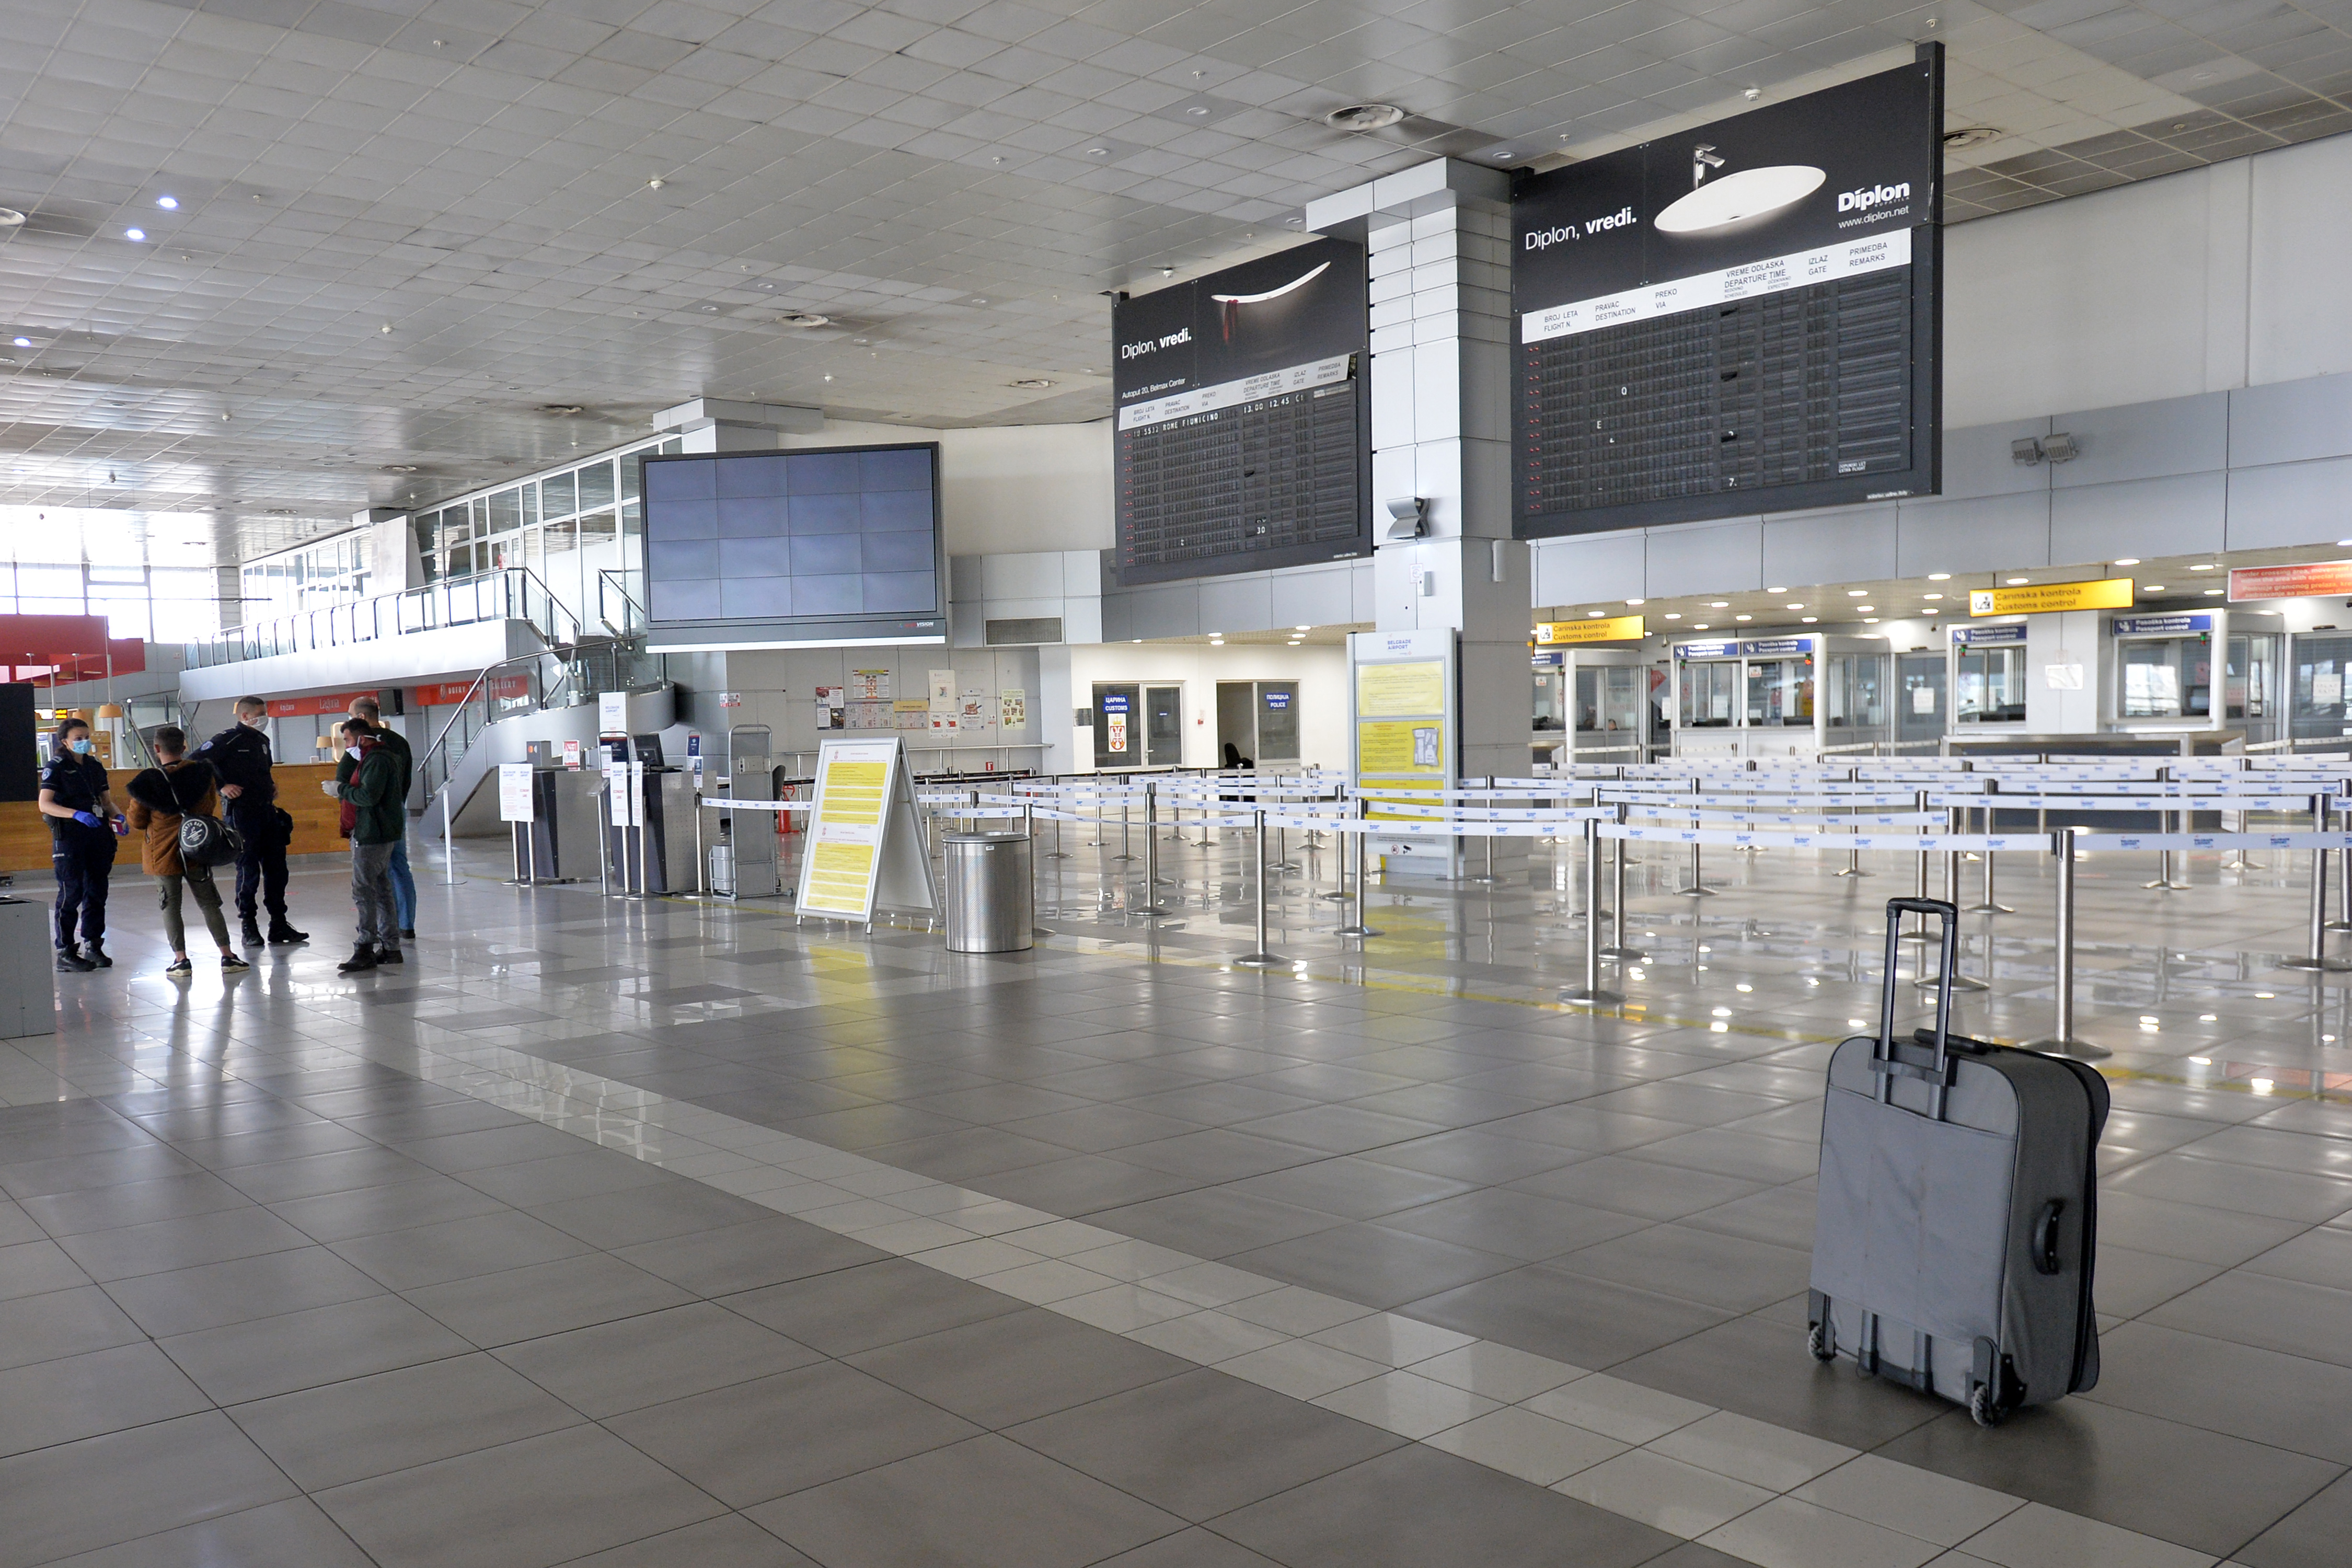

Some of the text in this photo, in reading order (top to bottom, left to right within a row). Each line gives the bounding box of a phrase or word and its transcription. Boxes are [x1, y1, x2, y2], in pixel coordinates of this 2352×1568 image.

[1838, 205, 1909, 229] www.diplon.net
[1526, 206, 1637, 250] Diplon, vredi.
[1849, 242, 1888, 256] PRIMEDBA
[1808, 255, 1828, 265] IZLAZ
[1849, 253, 1886, 267] REMARKS
[1726, 260, 1785, 278] VREME ODLASKA
[1808, 266, 1827, 275] GATE
[1725, 269, 1786, 289] DEPARTURE TIME
[1655, 289, 1678, 298] PREKO
[1595, 301, 1620, 312] PRAVAC
[1544, 310, 1578, 323] BROJ LETA
[1595, 307, 1636, 321] DESTINATION
[1544, 322, 1565, 332] FLIGHT
[1122, 327, 1192, 360] Diplon, vredi.
[1317, 371, 1339, 380] REMARKS
[1163, 421, 1178, 431] ROME
[1182, 412, 1219, 428] FIUMICINO
[1243, 402, 1264, 414] 13.00
[1269, 397, 1290, 408] 12.45
[1596, 420, 1602, 429] E
[1256, 526, 1266, 534] 30
[1995, 588, 2081, 601] Carinska kontrola
[1995, 599, 2077, 611] Customs control
[319, 698, 339, 711] Laguna
